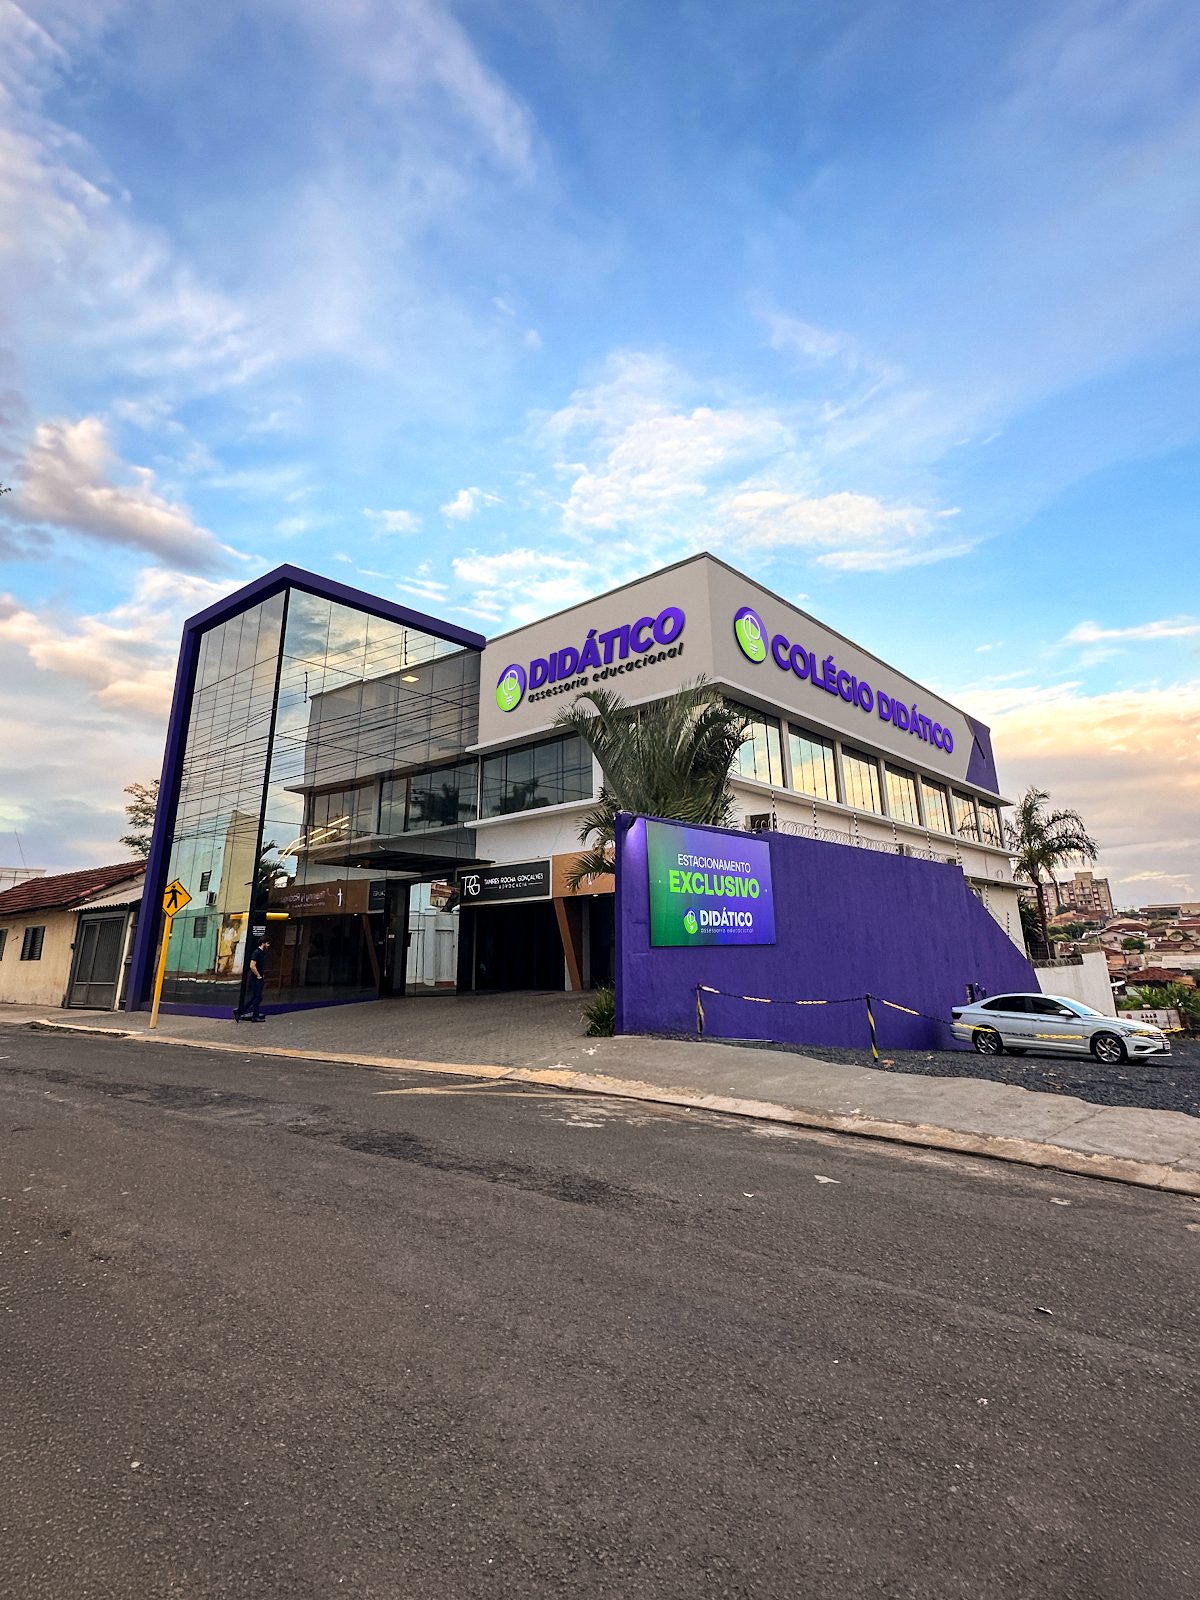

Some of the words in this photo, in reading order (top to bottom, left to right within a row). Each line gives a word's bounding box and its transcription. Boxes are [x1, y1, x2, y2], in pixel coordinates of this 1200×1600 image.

[528, 606, 686, 691] DIDÁTICO
[528, 675, 589, 703] assessoria
[592, 641, 685, 683] educacional
[771, 633, 875, 714] COLÉGIO
[876, 689, 954, 754] DIDÁTICO
[500, 875, 516, 883] ROCHA
[517, 872, 544, 882] GONÇALVES
[677, 853, 751, 874] ESTACIONAMENTO
[669, 869, 760, 899] EXCLUSIVO
[699, 906, 753, 927] DIDÁTICO
